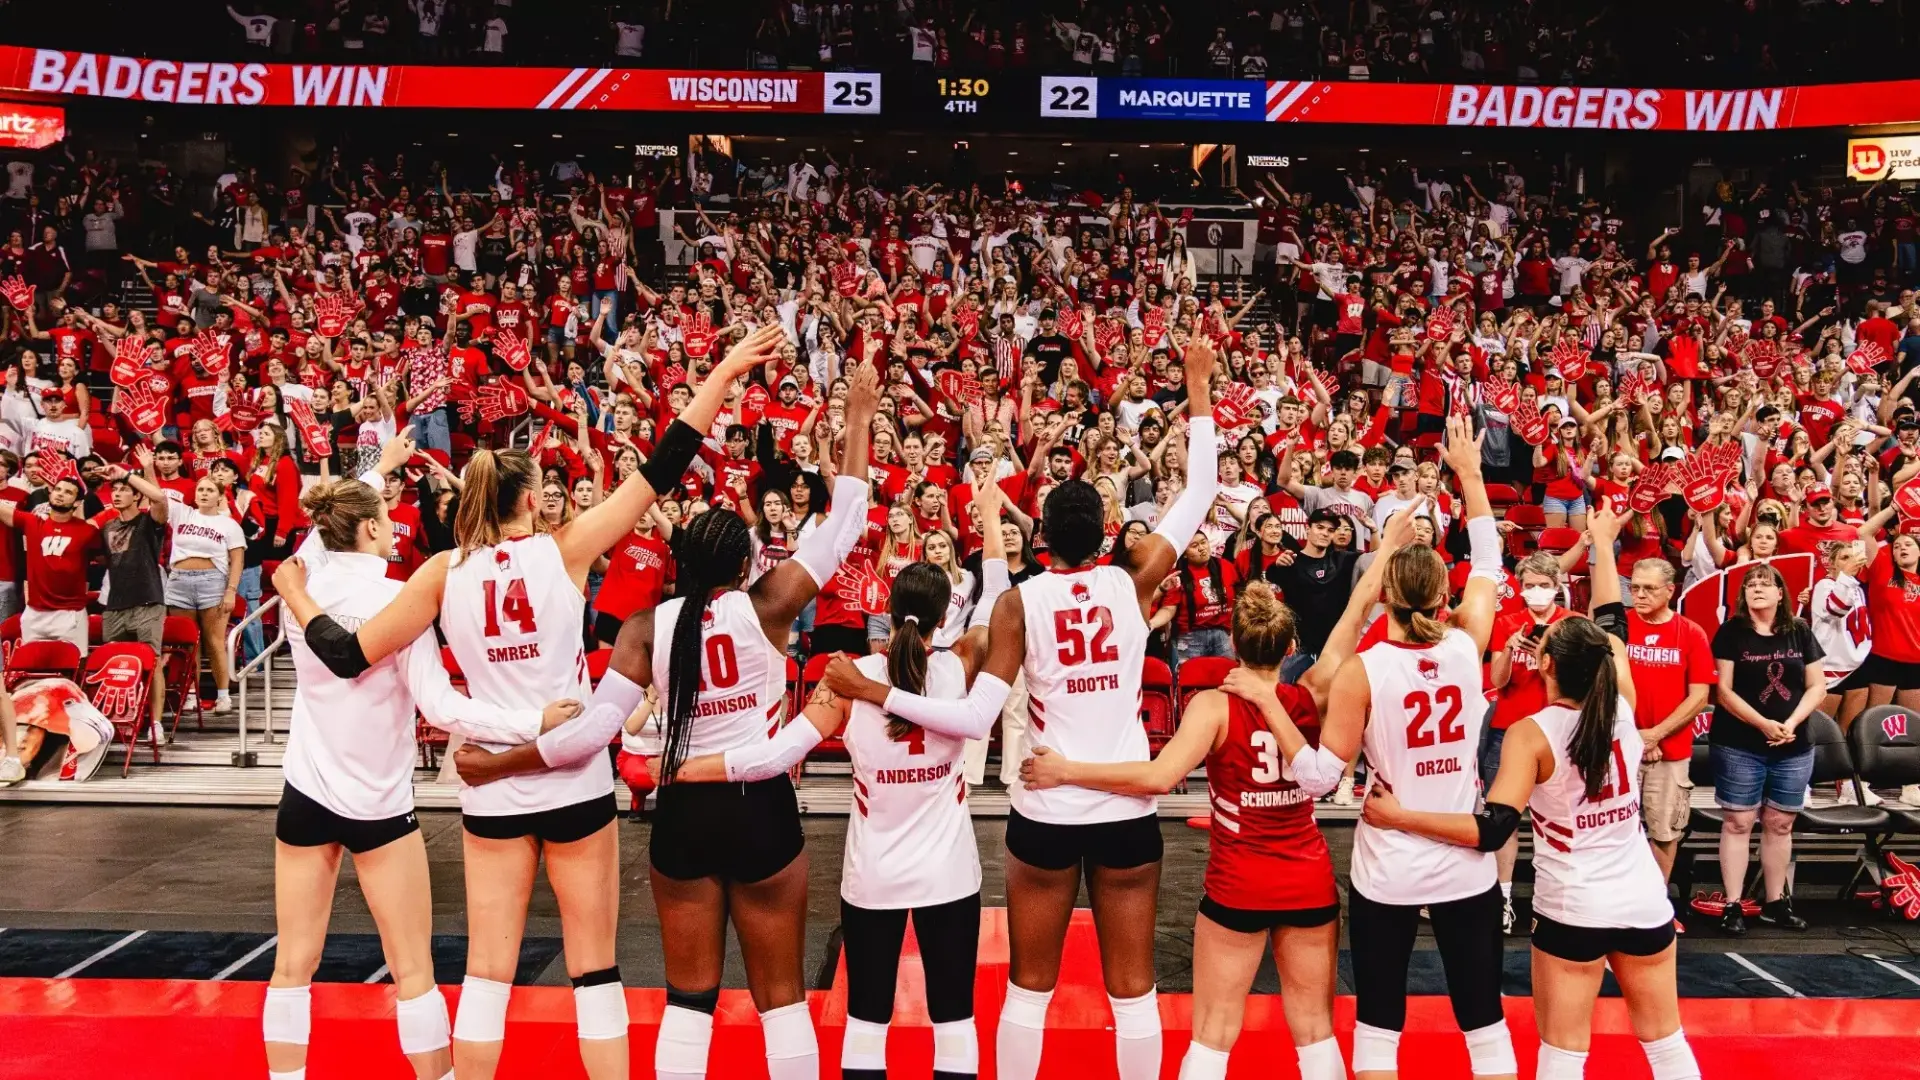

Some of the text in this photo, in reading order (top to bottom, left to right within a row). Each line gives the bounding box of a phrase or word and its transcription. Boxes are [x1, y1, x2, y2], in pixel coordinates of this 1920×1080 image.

[29, 49, 389, 106] BADGERS WIN
[938, 79, 989, 97] 1:30
[668, 78, 873, 106] WISCONSIN 25
[1050, 86, 1251, 110] 22 MARQUETTE
[945, 100, 977, 113] 4TH
[1447, 85, 1783, 131] BADGERS WIN
[1890, 149, 1912, 157] uw
[1802, 404, 1835, 419] BADGERS
[177, 523, 225, 544] WISCONSIN
[41, 536, 72, 557] W
[853, 545, 873, 556] CKEY
[482, 578, 538, 639] 14
[1053, 606, 1118, 668] 52
[1644, 635, 1660, 646] W
[487, 643, 541, 662] SMREK
[1741, 651, 1772, 662] Support
[1773, 650, 1785, 660] the
[1066, 674, 1119, 694] BOOTH
[1403, 684, 1466, 750] 22
[1882, 713, 1907, 740] W
[876, 761, 952, 784] ANDERSON
[1415, 757, 1462, 777] ORZOL
